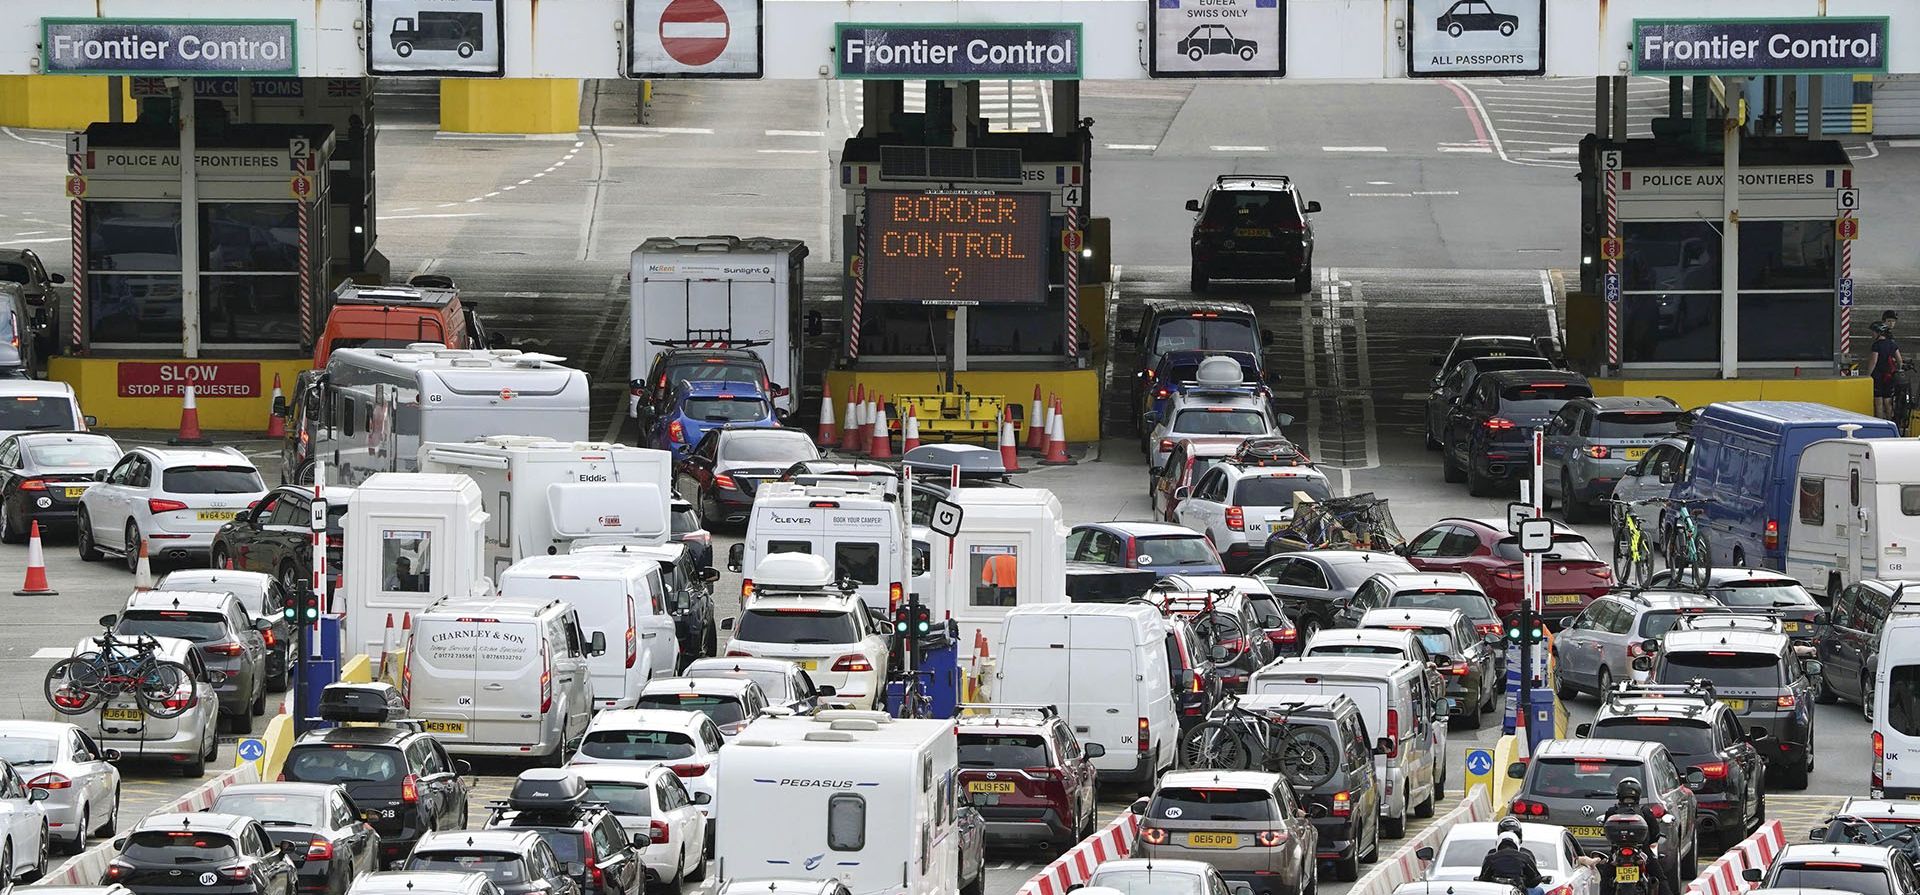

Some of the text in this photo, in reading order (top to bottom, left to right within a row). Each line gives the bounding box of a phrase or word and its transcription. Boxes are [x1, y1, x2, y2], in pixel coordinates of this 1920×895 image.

[1187, 9, 1248, 18] SWISS ONLY
[54, 35, 285, 60] Frontier Control
[846, 39, 1072, 64] Frontier Control
[1644, 33, 1877, 60] Frontier Control
[1431, 54, 1524, 65] ALL PASSPORTS
[195, 81, 216, 94] UK
[72, 137, 81, 152] 1
[294, 141, 305, 156] 2
[107, 155, 156, 166] POLICE
[1607, 153, 1617, 169] 5
[73, 177, 81, 195] STOP
[1642, 174, 1814, 187] POLICE AUX RONTIERES
[1067, 189, 1078, 204] 4
[1842, 192, 1853, 208] 6
[894, 196, 1017, 224] BORDER
[882, 232, 1025, 258] CONTROL
[944, 267, 962, 293] ?
[159, 366, 218, 381] SLOW
[128, 385, 250, 396] STOP IF RQUESTED
[69, 488, 86, 496] AJ5
[38, 499, 50, 507] UK
[314, 510, 322, 520] E
[940, 510, 953, 524] G
[1138, 555, 1151, 563] UK
[1889, 563, 1902, 571] GB
[432, 630, 491, 643] CHARNLEY
[503, 633, 525, 644] SON
[459, 697, 471, 706] UK
[445, 721, 462, 732] YRN
[1121, 736, 1133, 744] UK
[780, 778, 853, 788] PEGASUS
[973, 782, 1011, 792] KL19 FSN
[1167, 808, 1179, 816] UK
[202, 874, 215, 884] UK
